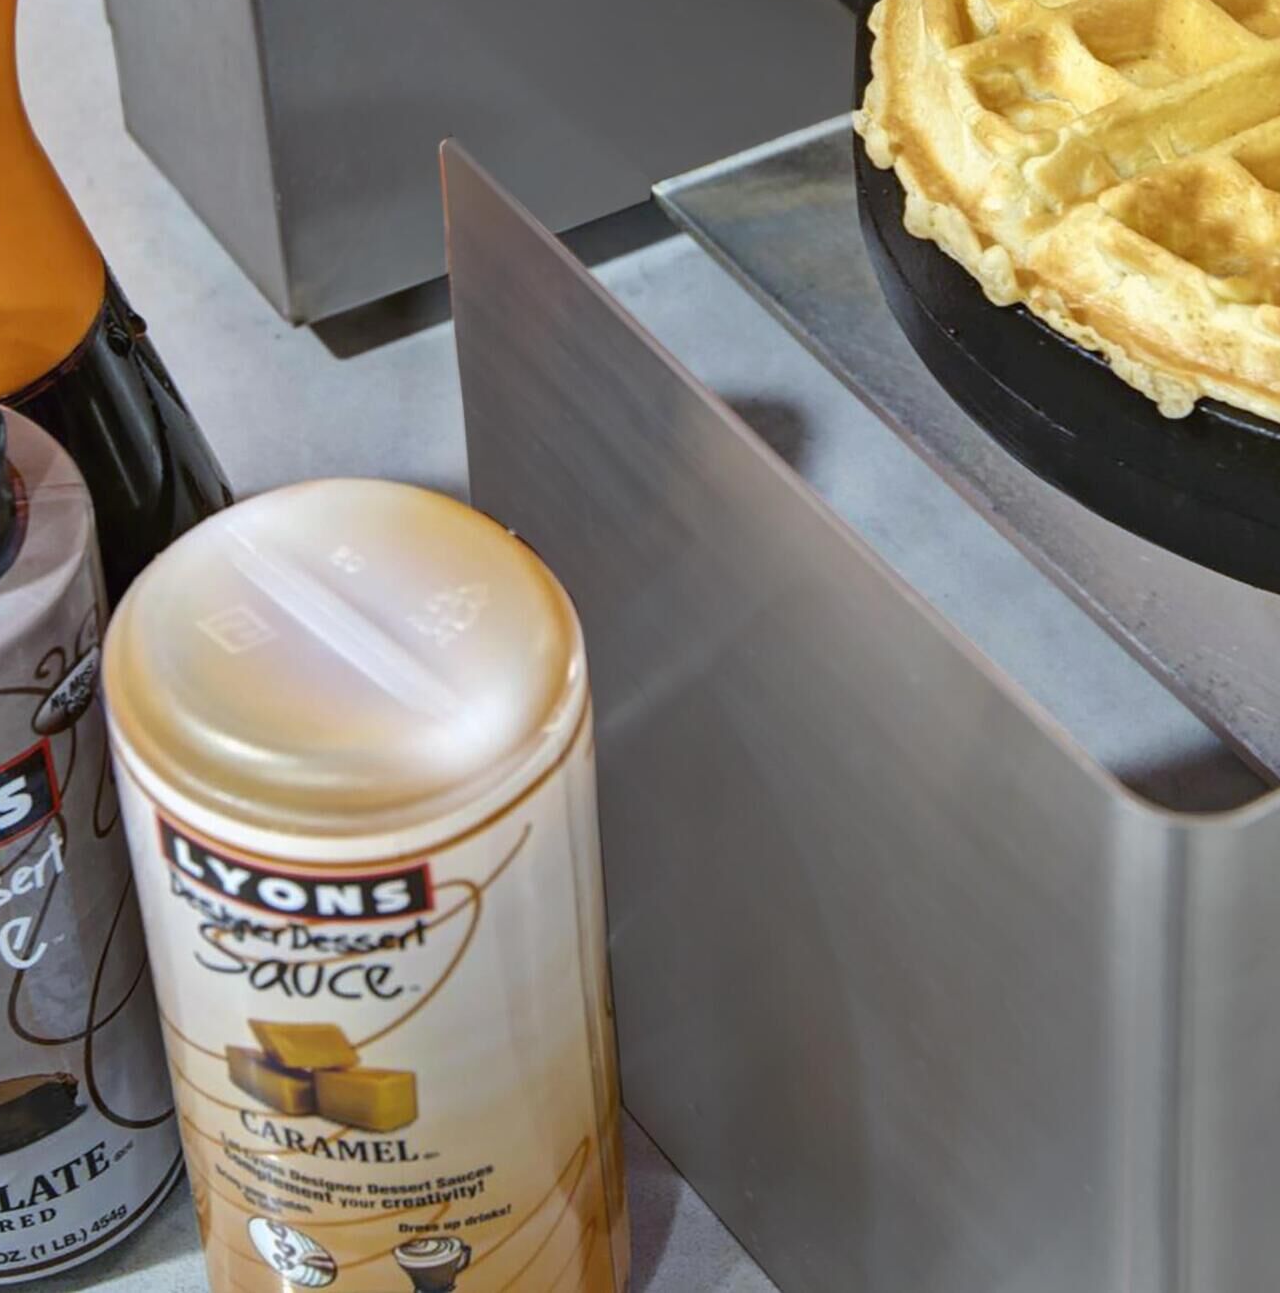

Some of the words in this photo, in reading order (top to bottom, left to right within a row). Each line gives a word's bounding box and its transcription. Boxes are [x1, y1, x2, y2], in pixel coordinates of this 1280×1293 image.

[173, 837, 412, 916] LYONS
[287, 919, 430, 954] Dessert
[194, 921, 404, 999] Sauce
[239, 1108, 419, 1165] CARAMEL
[289, 1168, 363, 1196] Designer
[366, 1179, 432, 1196] Dessert
[435, 1164, 495, 1190] Sauces
[381, 1179, 487, 1211] creativity!
[30, 1245, 47, 1260] (1
[51, 1227, 88, 1252] LB.)
